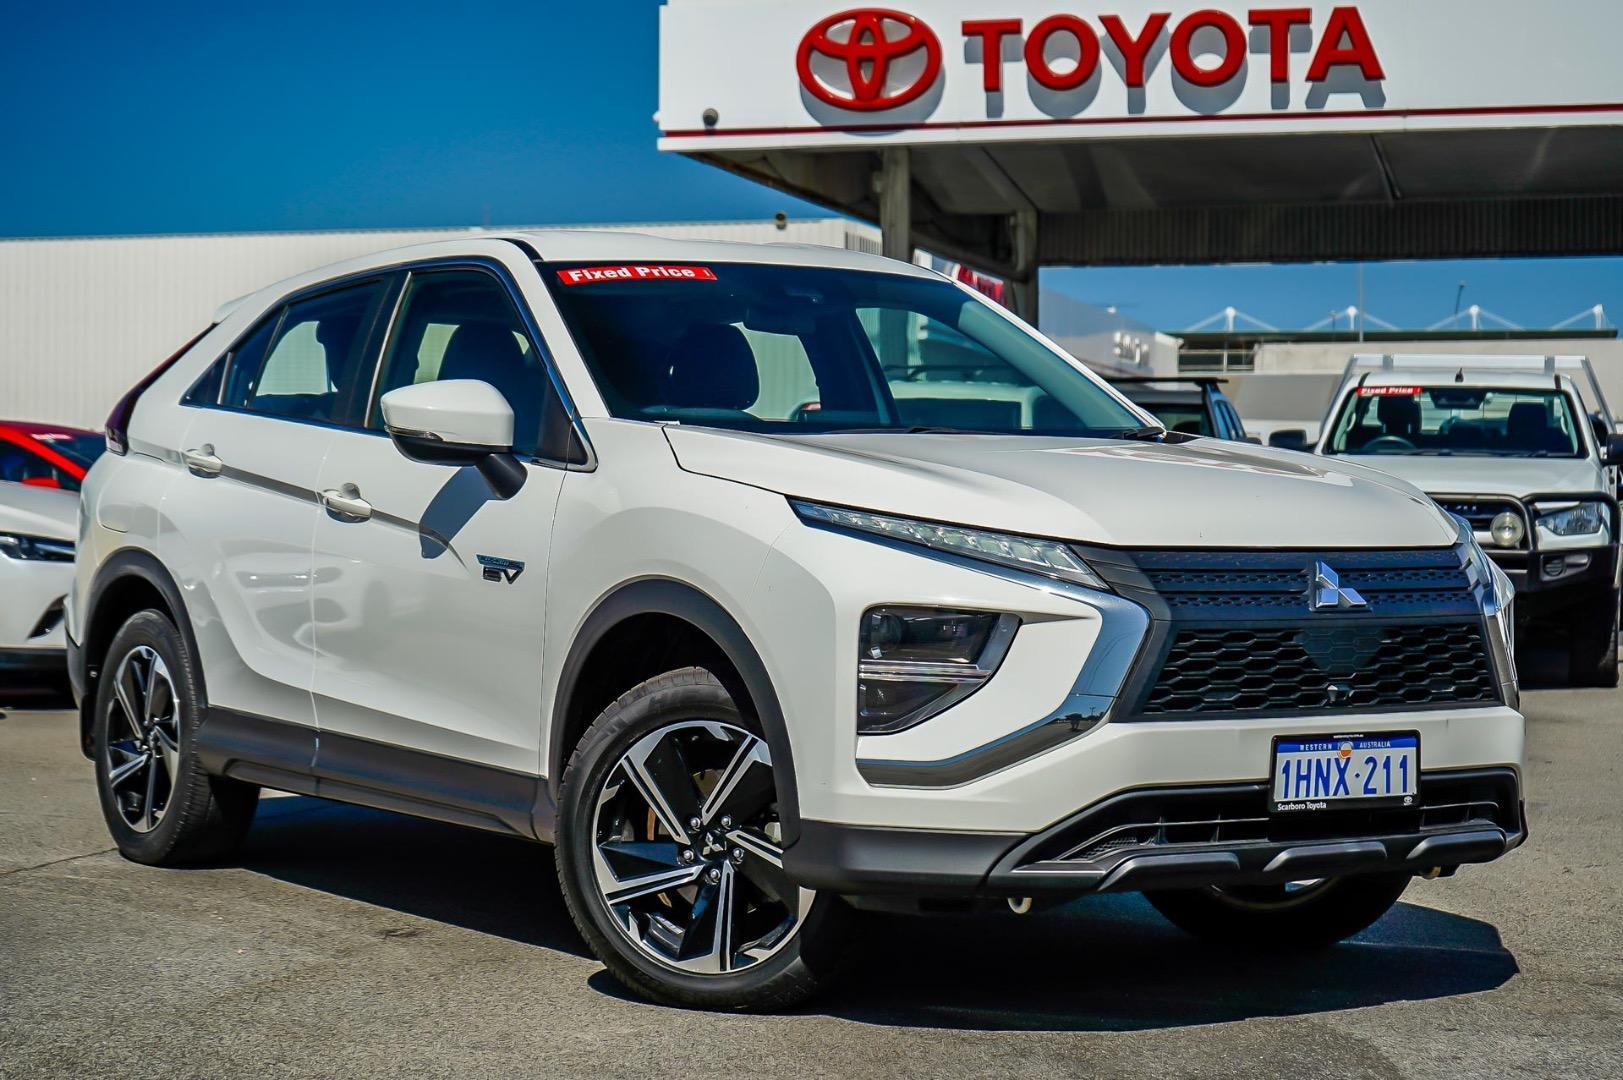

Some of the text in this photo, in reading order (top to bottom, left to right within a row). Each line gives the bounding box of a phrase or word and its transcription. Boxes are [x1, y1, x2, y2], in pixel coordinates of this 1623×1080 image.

[962, 7, 1386, 92] TOYOTA
[568, 266, 696, 282] Fixed Price
[1360, 387, 1414, 395] Fixed Price
[1299, 740, 1391, 751] WESTERN AUSTRALIA
[1277, 801, 1327, 812] Scarboro Toyota
